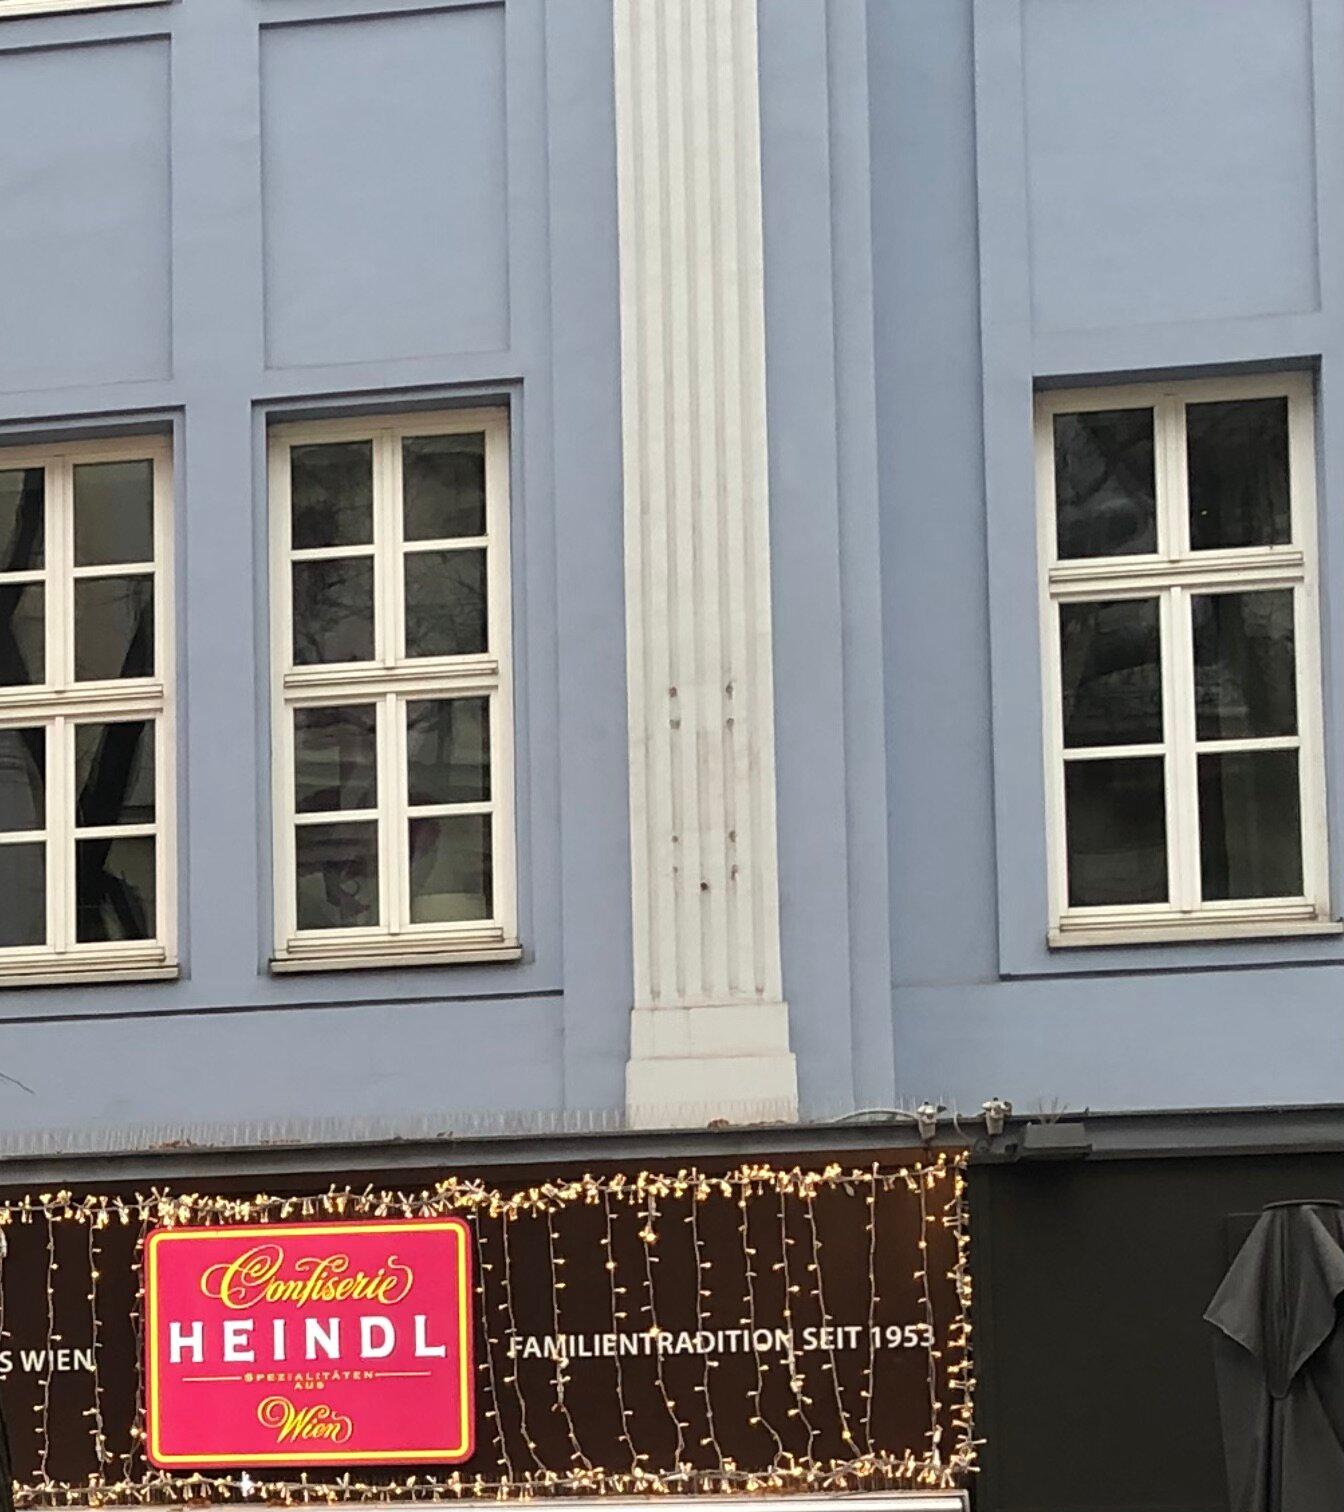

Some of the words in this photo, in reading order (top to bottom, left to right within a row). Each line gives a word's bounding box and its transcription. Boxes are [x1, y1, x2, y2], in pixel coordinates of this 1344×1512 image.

[201, 1244, 413, 1310] Confiserie
[169, 1315, 446, 1363] HEINDL
[509, 1328, 793, 1360] FAMILIENTRADITION
[802, 1325, 862, 1351] SEIT
[871, 1322, 936, 1348] 1953
[19, 1348, 96, 1373] WIEN
[242, 1369, 375, 1383] SPEZIALITÄTEN
[294, 1380, 325, 1390] AUS
[257, 1395, 353, 1443] Wien
